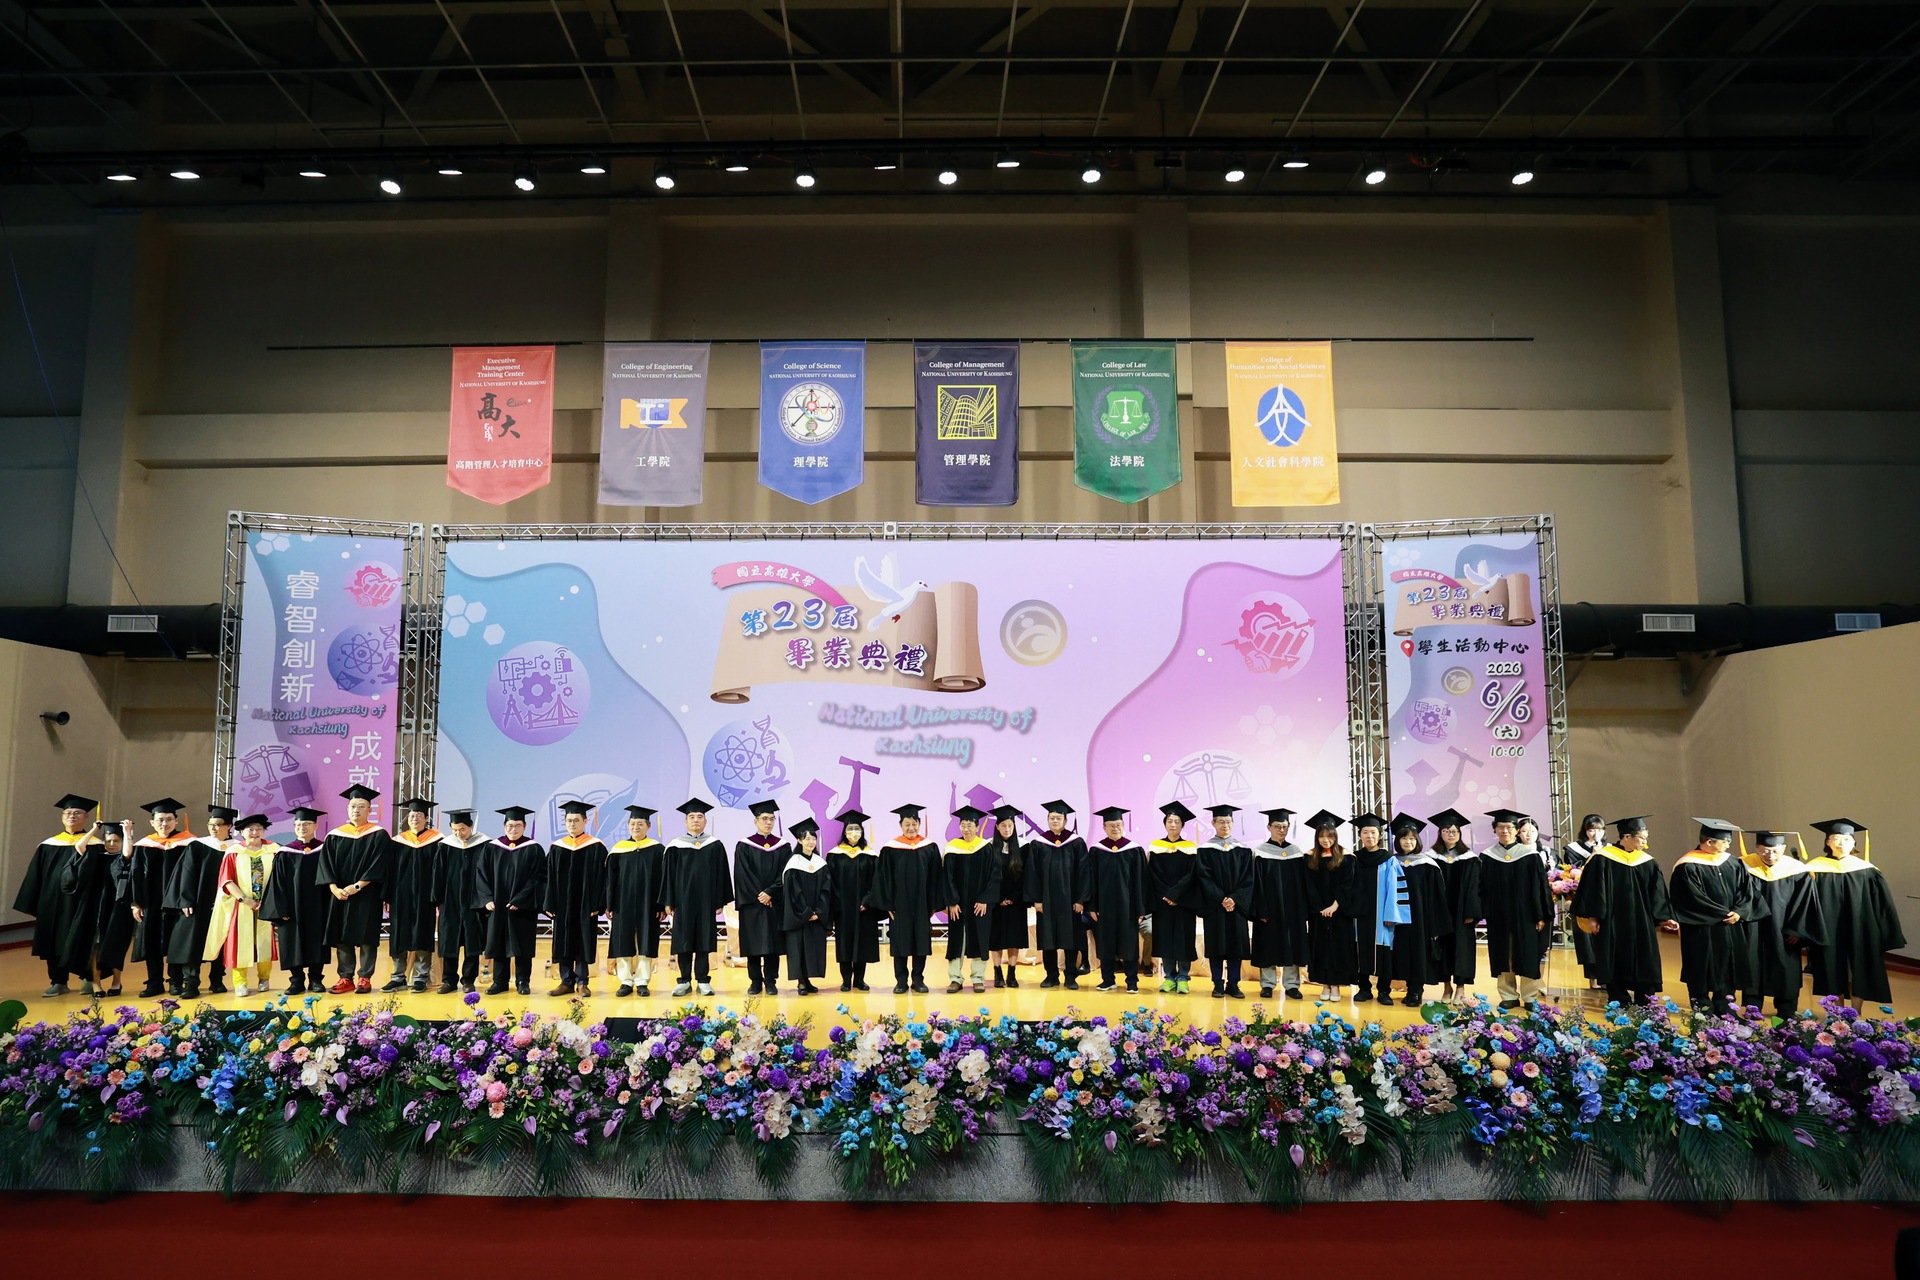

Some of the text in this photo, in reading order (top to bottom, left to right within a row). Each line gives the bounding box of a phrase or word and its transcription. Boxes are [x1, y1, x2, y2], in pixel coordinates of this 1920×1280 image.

[621, 363, 645, 371] College
[654, 363, 693, 371] Engineering
[929, 361, 953, 369] College
[962, 361, 1005, 369] Management
[455, 458, 544, 470] 高階管理人才培育中心
[635, 456, 671, 467] 工學院
[793, 456, 829, 467] 理學院
[943, 454, 991, 466] 管理學院
[1109, 456, 1145, 467] 法學院
[1242, 456, 1325, 468] 人文社會科學院
[736, 565, 816, 588] 國立高雄大學
[1407, 585, 1468, 605] 第23屆
[740, 598, 858, 637] 第23屆
[1431, 604, 1505, 619] 畢業典禮
[280, 570, 320, 703] 睿智創新
[1417, 637, 1529, 656] 學生活動中心
[785, 637, 928, 677] 畢業典禮
[1487, 662, 1522, 675] 2026
[1481, 680, 1531, 727] 6/6
[252, 704, 386, 721] National University of
[819, 704, 1034, 731] National University of
[288, 722, 348, 739] Kaohsiung
[1493, 724, 1521, 739] (六)
[875, 734, 971, 766] Kaohsiung
[1490, 745, 1525, 758] 10:00
